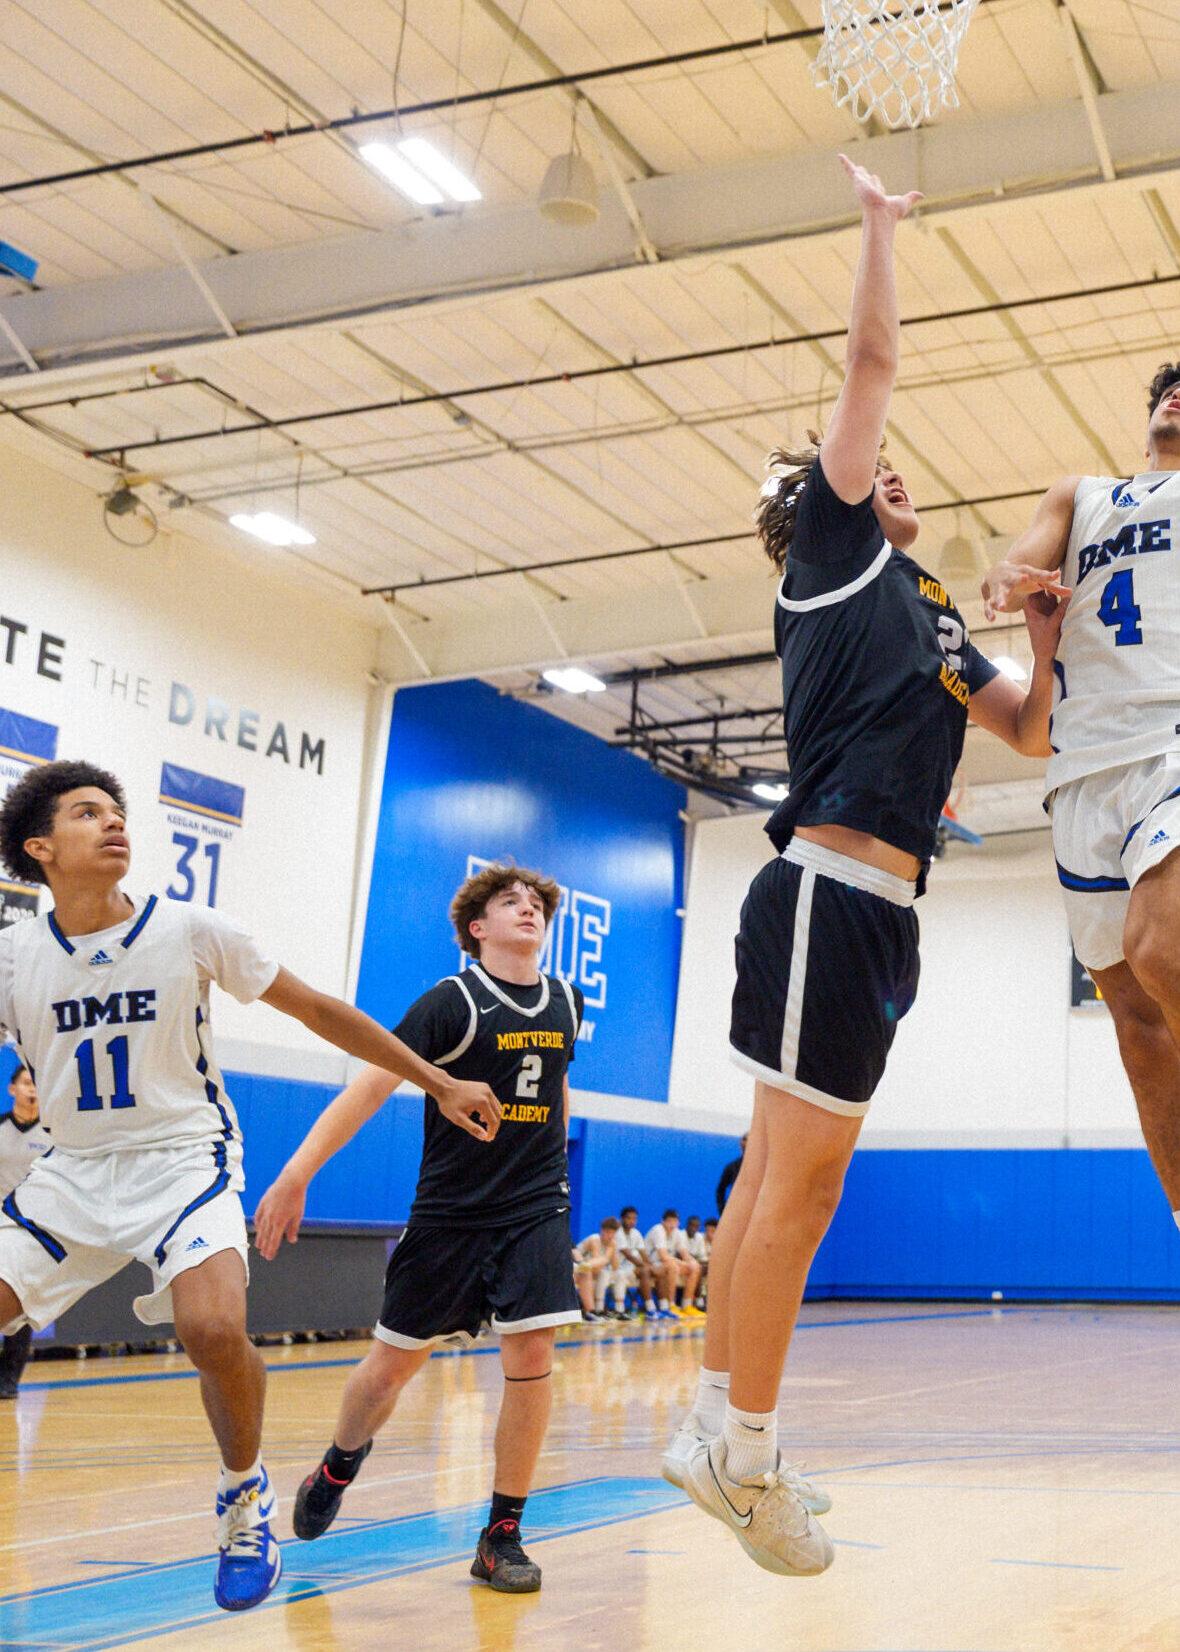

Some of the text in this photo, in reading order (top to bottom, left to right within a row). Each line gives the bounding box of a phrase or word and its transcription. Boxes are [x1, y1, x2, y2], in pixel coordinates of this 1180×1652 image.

[1076, 518, 1171, 586] DME
[1097, 568, 1143, 646] 4
[90, 658, 151, 708] THE
[168, 680, 325, 776] DREAM
[167, 813, 233, 841] KEEGAN MURRAY
[166, 831, 221, 908] 31
[51, 989, 156, 1033] DME
[497, 1031, 564, 1051] MONTVERDE
[74, 1035, 136, 1111] 11
[515, 1054, 543, 1099] 2
[501, 1103, 551, 1123] CADEMY
